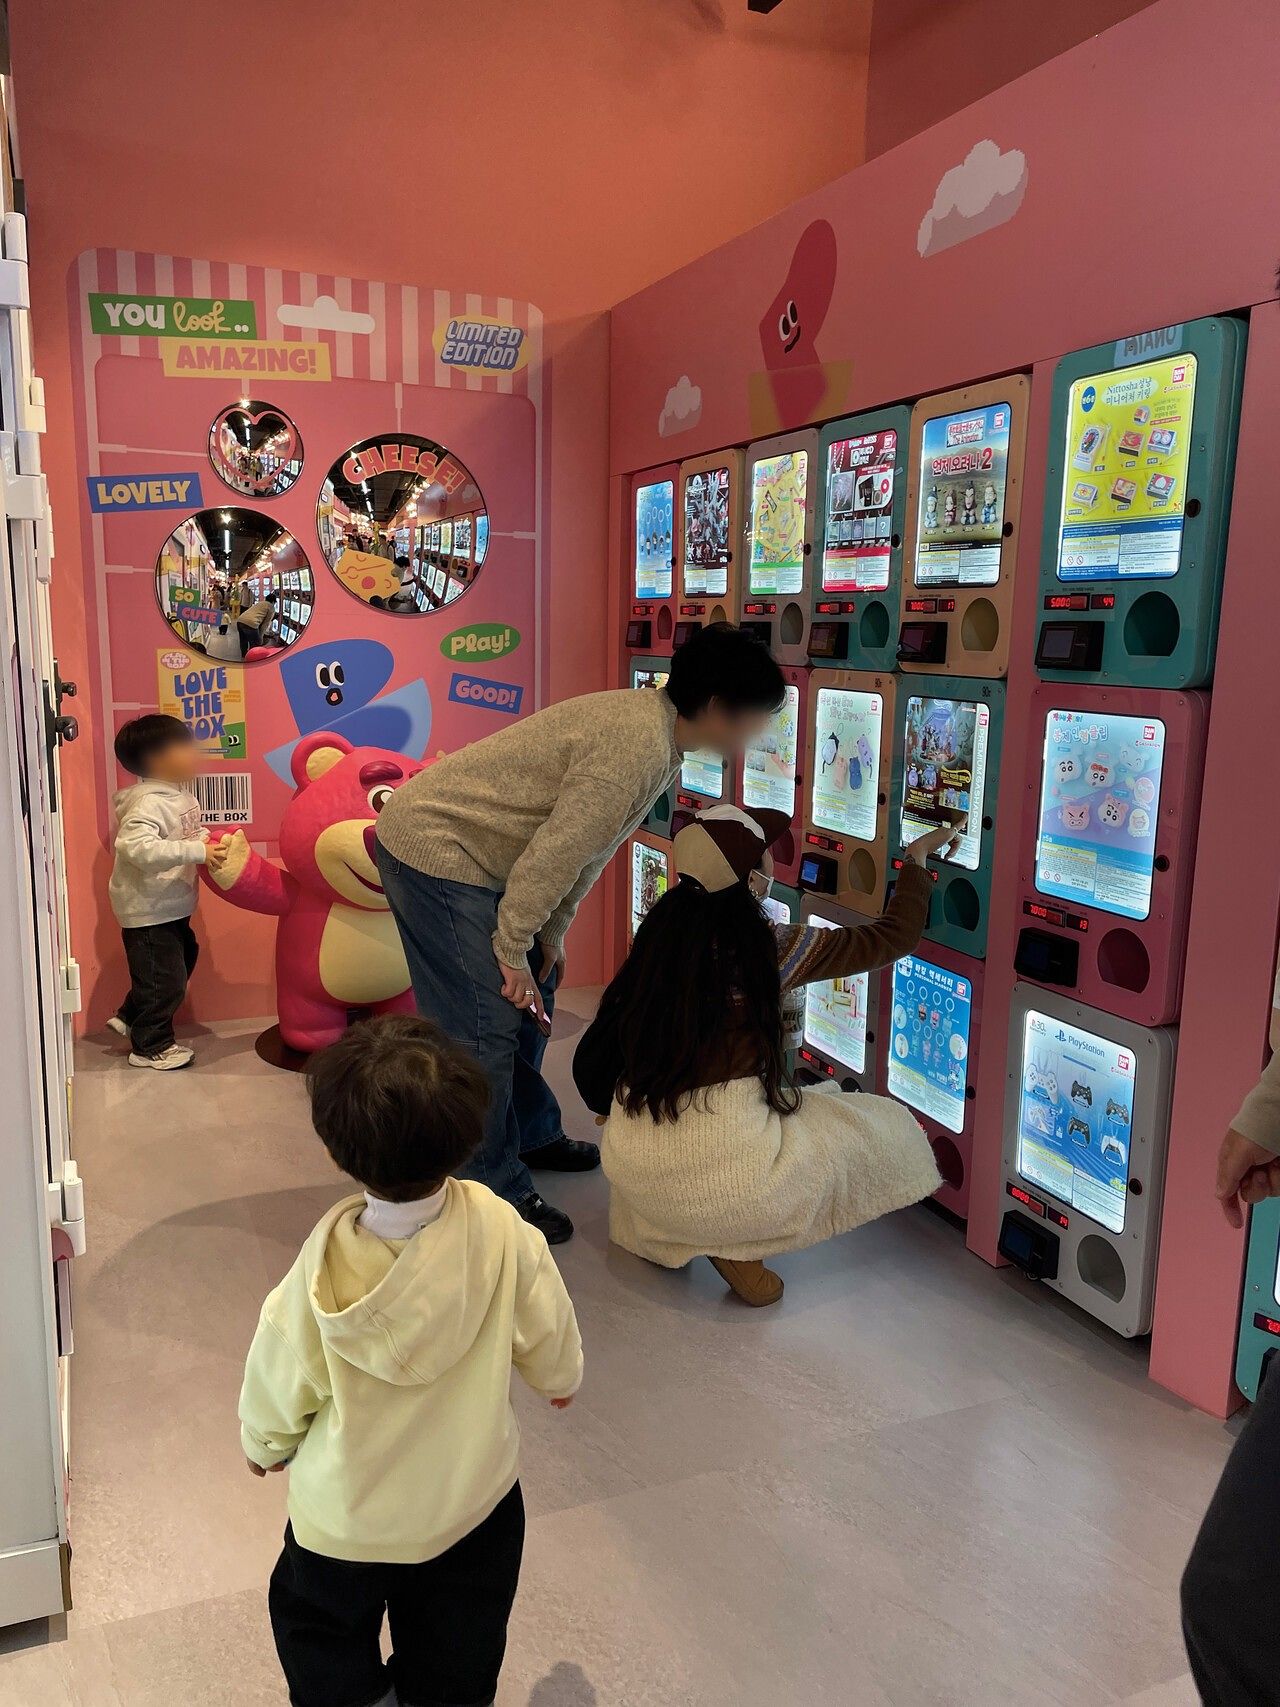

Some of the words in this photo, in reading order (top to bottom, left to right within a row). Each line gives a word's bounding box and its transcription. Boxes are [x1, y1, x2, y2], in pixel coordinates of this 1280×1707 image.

[103, 303, 165, 330] YOU
[446, 321, 523, 347] LIMITED
[176, 345, 316, 375] AMAZING!
[441, 341, 518, 368] EDITION
[342, 444, 466, 494] CHEESE!
[96, 480, 191, 505] LOVELY
[175, 587, 195, 603] SO
[182, 606, 218, 624] CUTE
[174, 666, 227, 698] LOVE
[455, 680, 517, 709] GOOD!
[182, 691, 222, 720] THE
[224, 812, 248, 822] BOX
[1068, 1035, 1105, 1058] PlayStation
